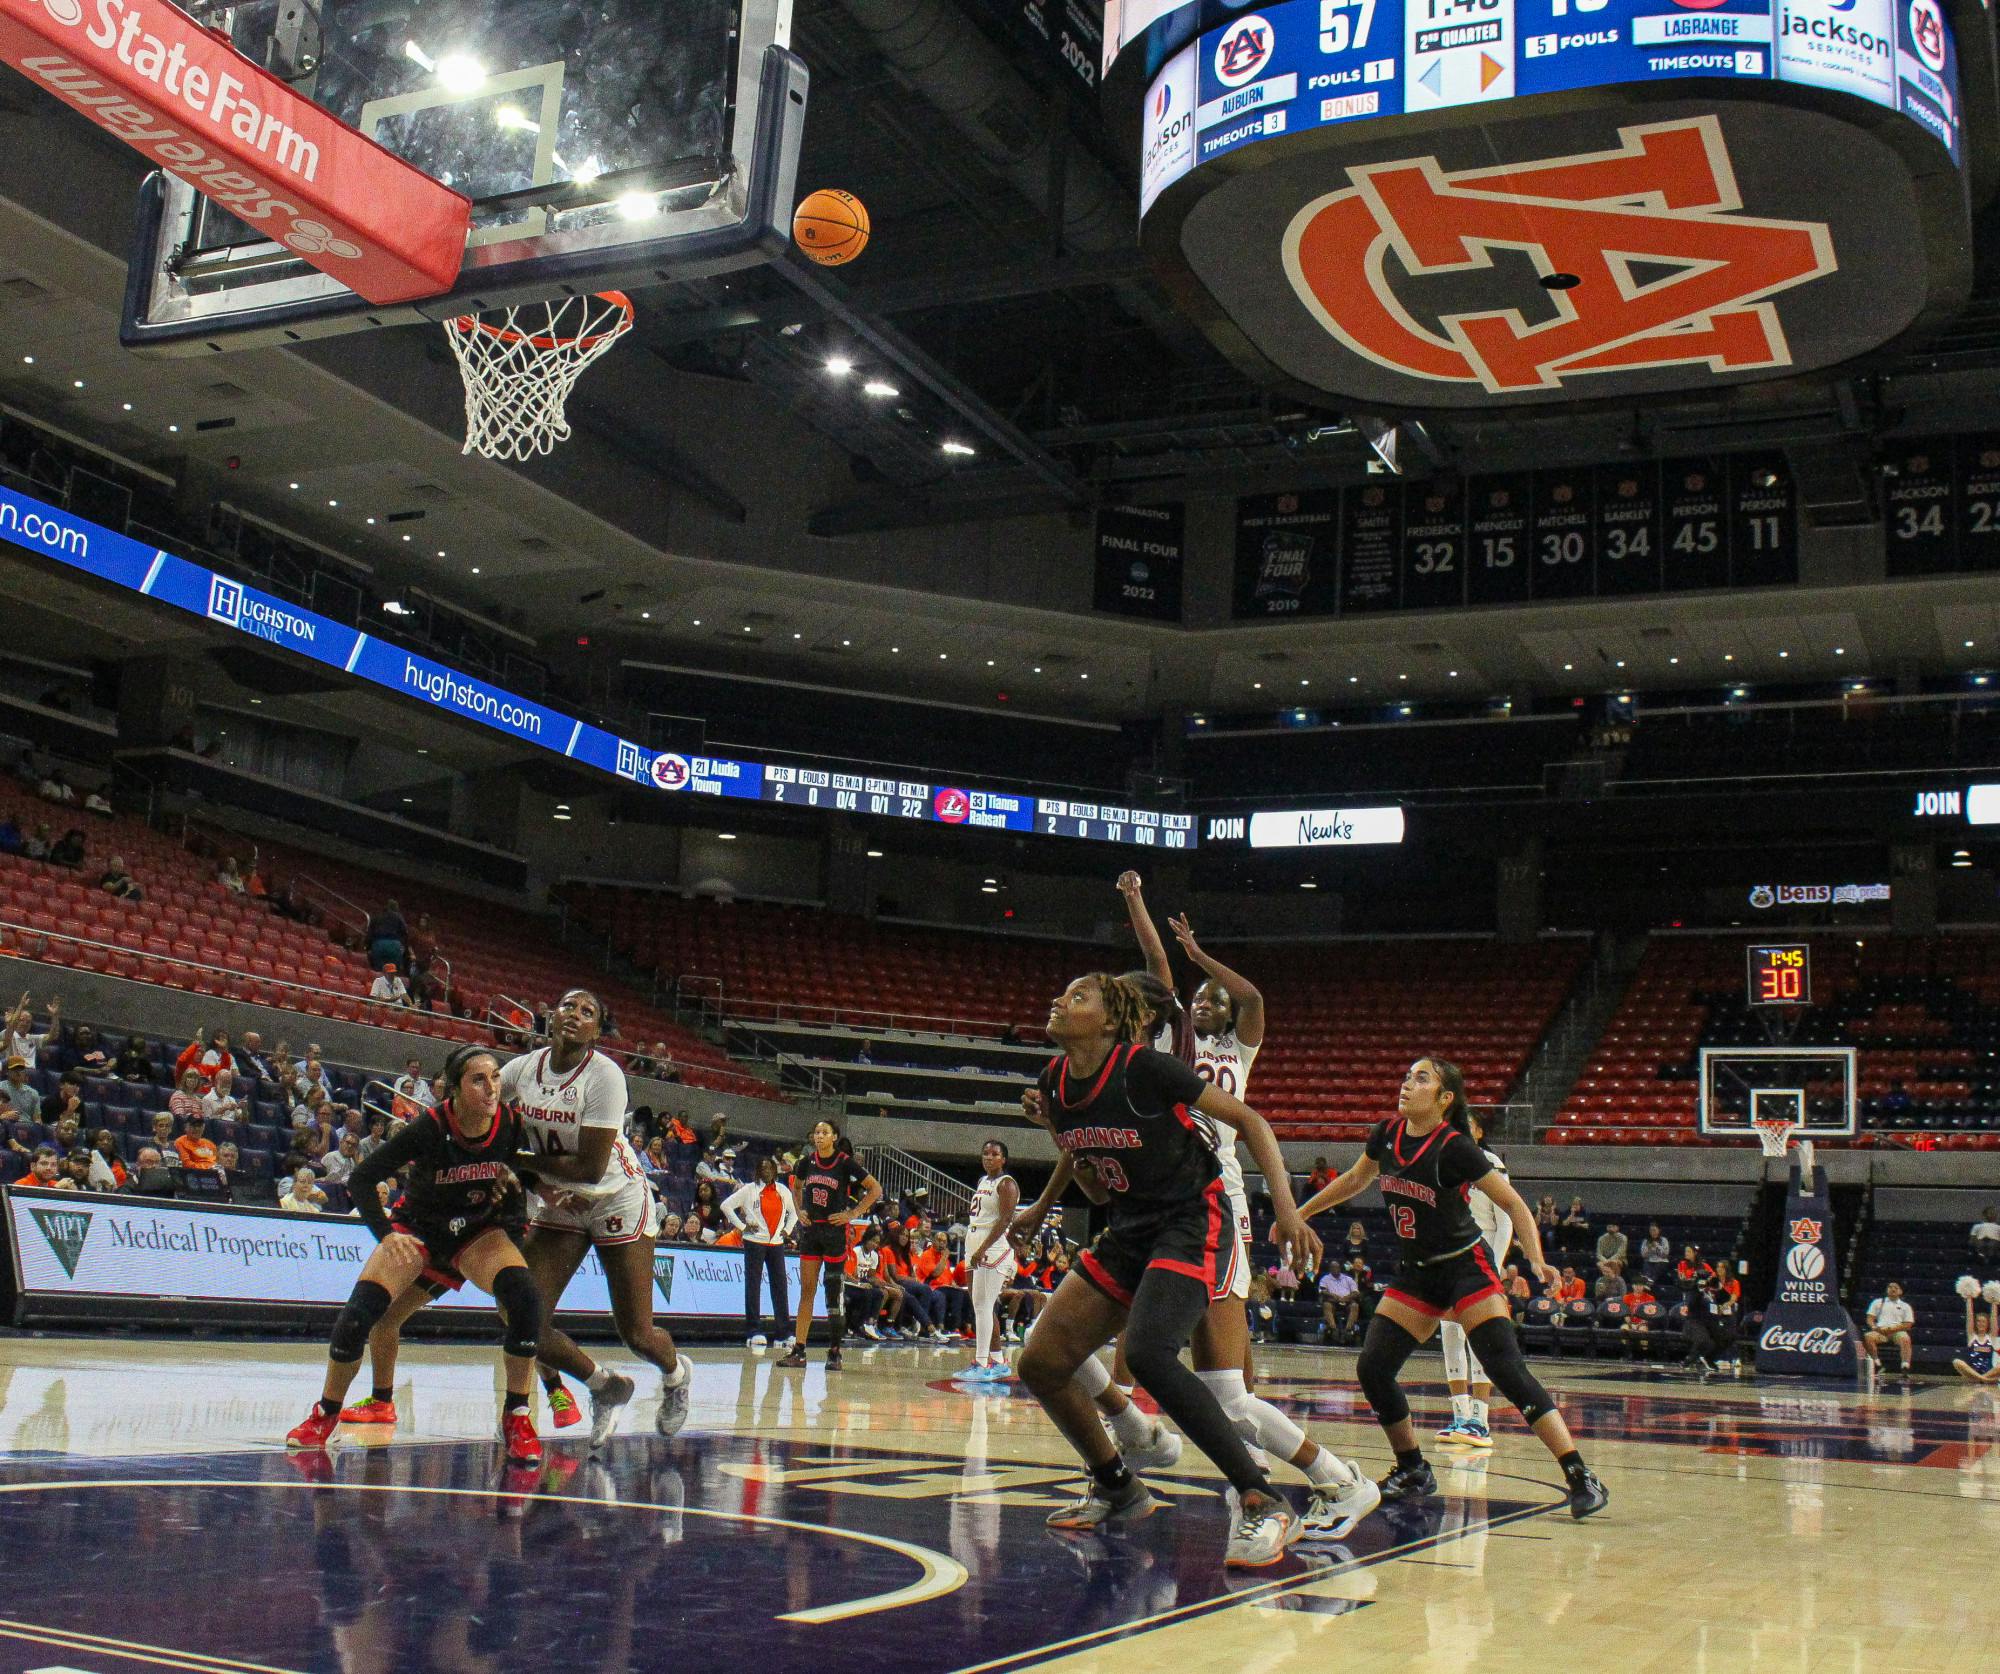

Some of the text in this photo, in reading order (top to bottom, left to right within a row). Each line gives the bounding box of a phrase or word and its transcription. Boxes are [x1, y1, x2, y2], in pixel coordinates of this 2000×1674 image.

[1319, 0, 1376, 54] 57
[1440, 26, 1499, 48] QUARTER
[1664, 18, 1739, 37] LAGRANGE
[1782, 7, 1890, 58] jackson
[1537, 29, 1619, 54] 5 FOULS
[1648, 54, 1752, 71] TIMEOUTS 2
[1808, 41, 1873, 66] SERVICES
[1308, 63, 1380, 90] FOULS 1
[1221, 86, 1264, 117] AUBURN
[1324, 95, 1375, 119] BONUS
[1203, 114, 1279, 153] TIMEOUTS 3
[1672, 502, 1718, 517] PERSON
[1739, 498, 1787, 512] PERSON
[1537, 513, 1588, 528] MITCHELL
[1604, 508, 1651, 523] BARKLEY
[1896, 504, 1945, 540] 34
[1406, 523, 1462, 537] FREDERICK
[1672, 521, 1719, 553] 45
[1749, 516, 1780, 550] 11
[1101, 535, 1179, 559] FINAL FOUR
[1482, 537, 1515, 568] 15
[1541, 531, 1585, 566] 30
[1607, 526, 1651, 560] 34
[1268, 549, 1306, 563] FINAL
[1414, 542, 1455, 575] 32
[1263, 563, 1303, 578] FOUR
[1122, 584, 1155, 600] 2022
[1266, 600, 1300, 612] 2019
[240, 615, 282, 644] CLINIC
[404, 657, 542, 735] hughston.com
[696, 760, 740, 778] 21 Audia
[773, 768, 789, 781] PTS
[802, 771, 826, 785] FOULS
[691, 776, 722, 796] Young
[775, 783, 785, 801] 2
[808, 787, 819, 806] 0
[836, 790, 857, 811] 0/4
[871, 795, 889, 814] 0/1
[972, 794, 1019, 812] 33 Tianna
[1914, 792, 1961, 816] JOIN
[901, 798, 923, 819] 2/2
[1046, 801, 1060, 814] PTS
[1073, 804, 1094, 818] FOULS
[1047, 816, 1057, 834] 2
[1078, 820, 1088, 837] 0
[1107, 823, 1121, 842] 1/1
[1207, 818, 1245, 840] JOIN
[1298, 811, 1352, 844] Newk's
[1135, 826, 1156, 846] 0/0
[1165, 830, 1186, 849] 0/0
[1778, 885, 1829, 903] Bens
[1770, 950, 1804, 967] 1:45
[1761, 968, 1800, 998] 30
[812, 1187, 829, 1207] 22
[43, 1213, 85, 1241] MPT
[1389, 1204, 1416, 1239] 12
[109, 1218, 364, 1267] Medical Properties Trust
[685, 1260, 733, 1283] Medical
[1784, 1280, 1826, 1293] WIND
[1780, 1292, 1829, 1304] CREEK
[1760, 1325, 1847, 1355] Coca-Cola
